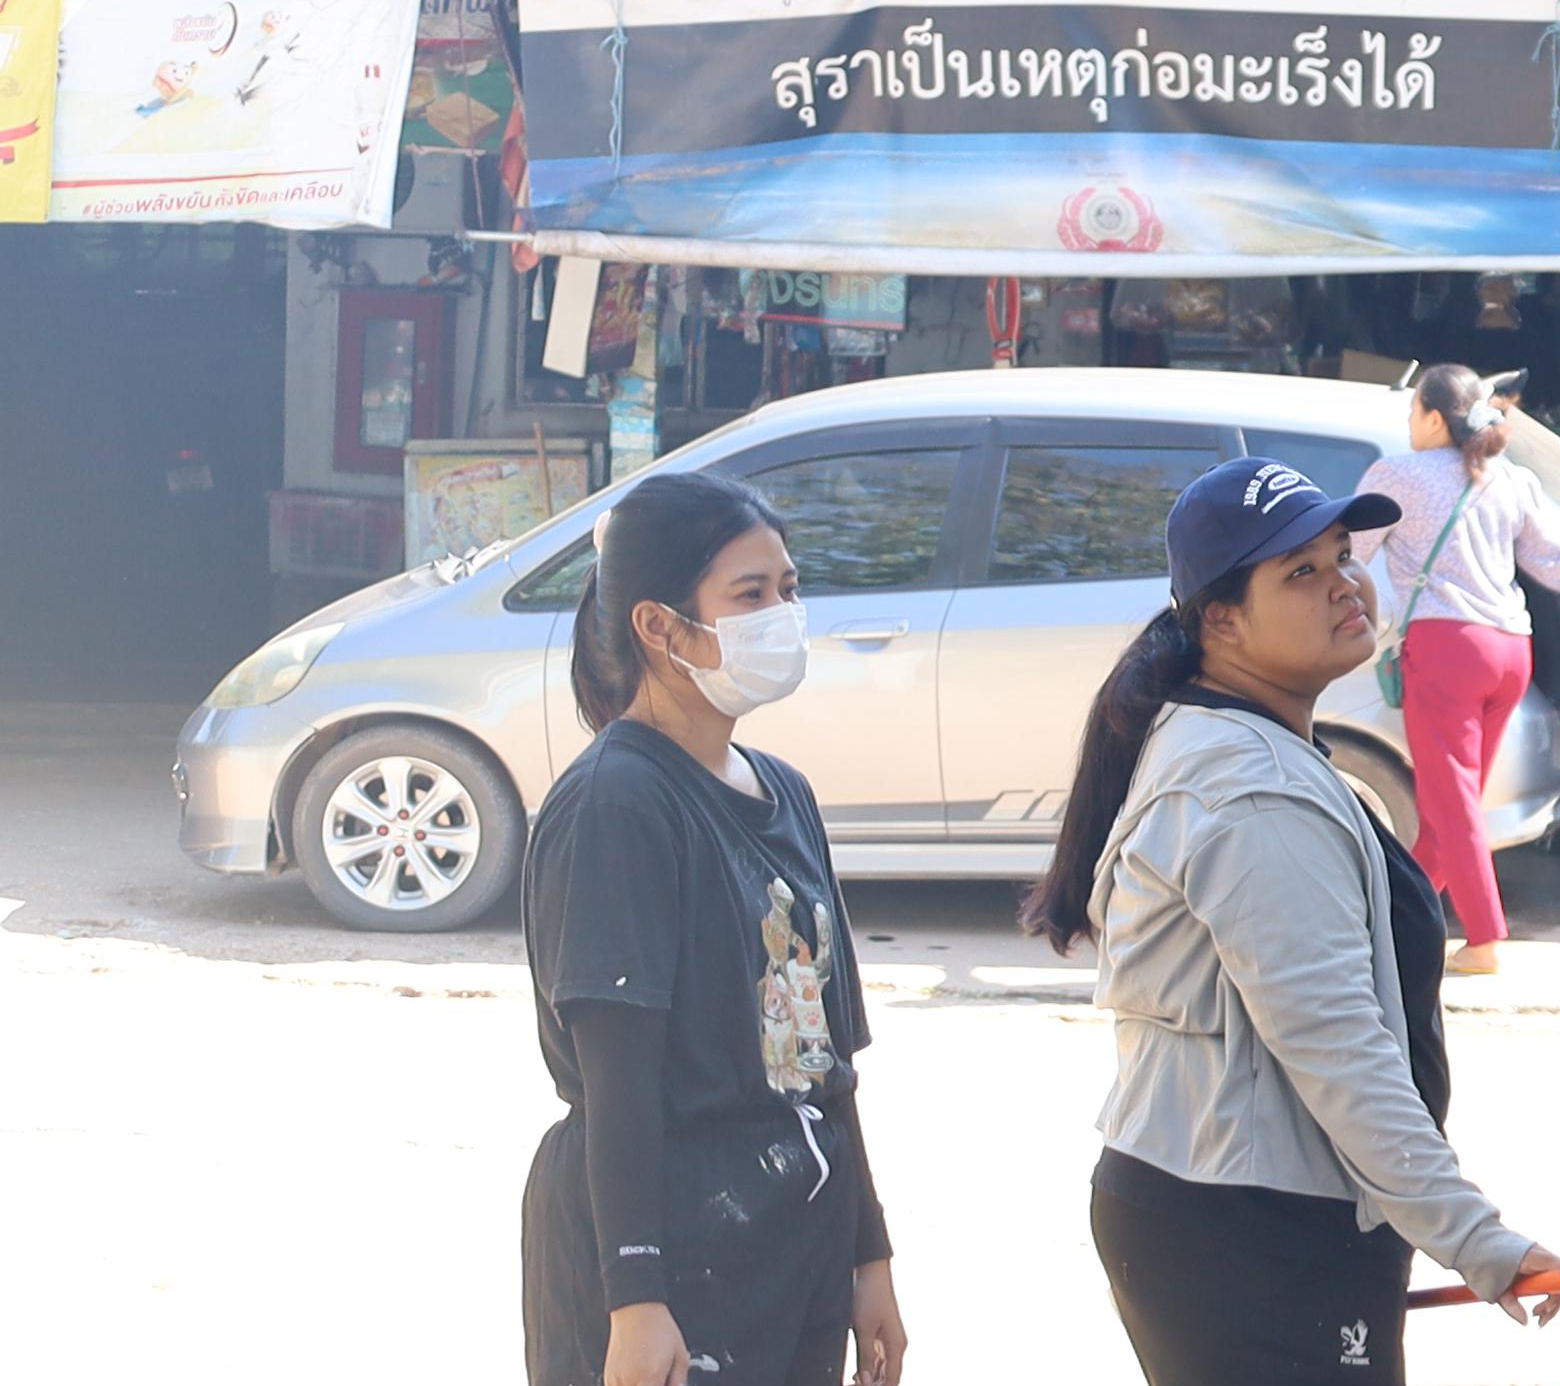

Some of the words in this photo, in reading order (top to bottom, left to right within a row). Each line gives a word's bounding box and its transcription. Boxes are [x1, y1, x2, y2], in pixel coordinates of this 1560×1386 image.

[771, 18, 1442, 128] สุราเป็นเหตุก่อมะเร็งได้
